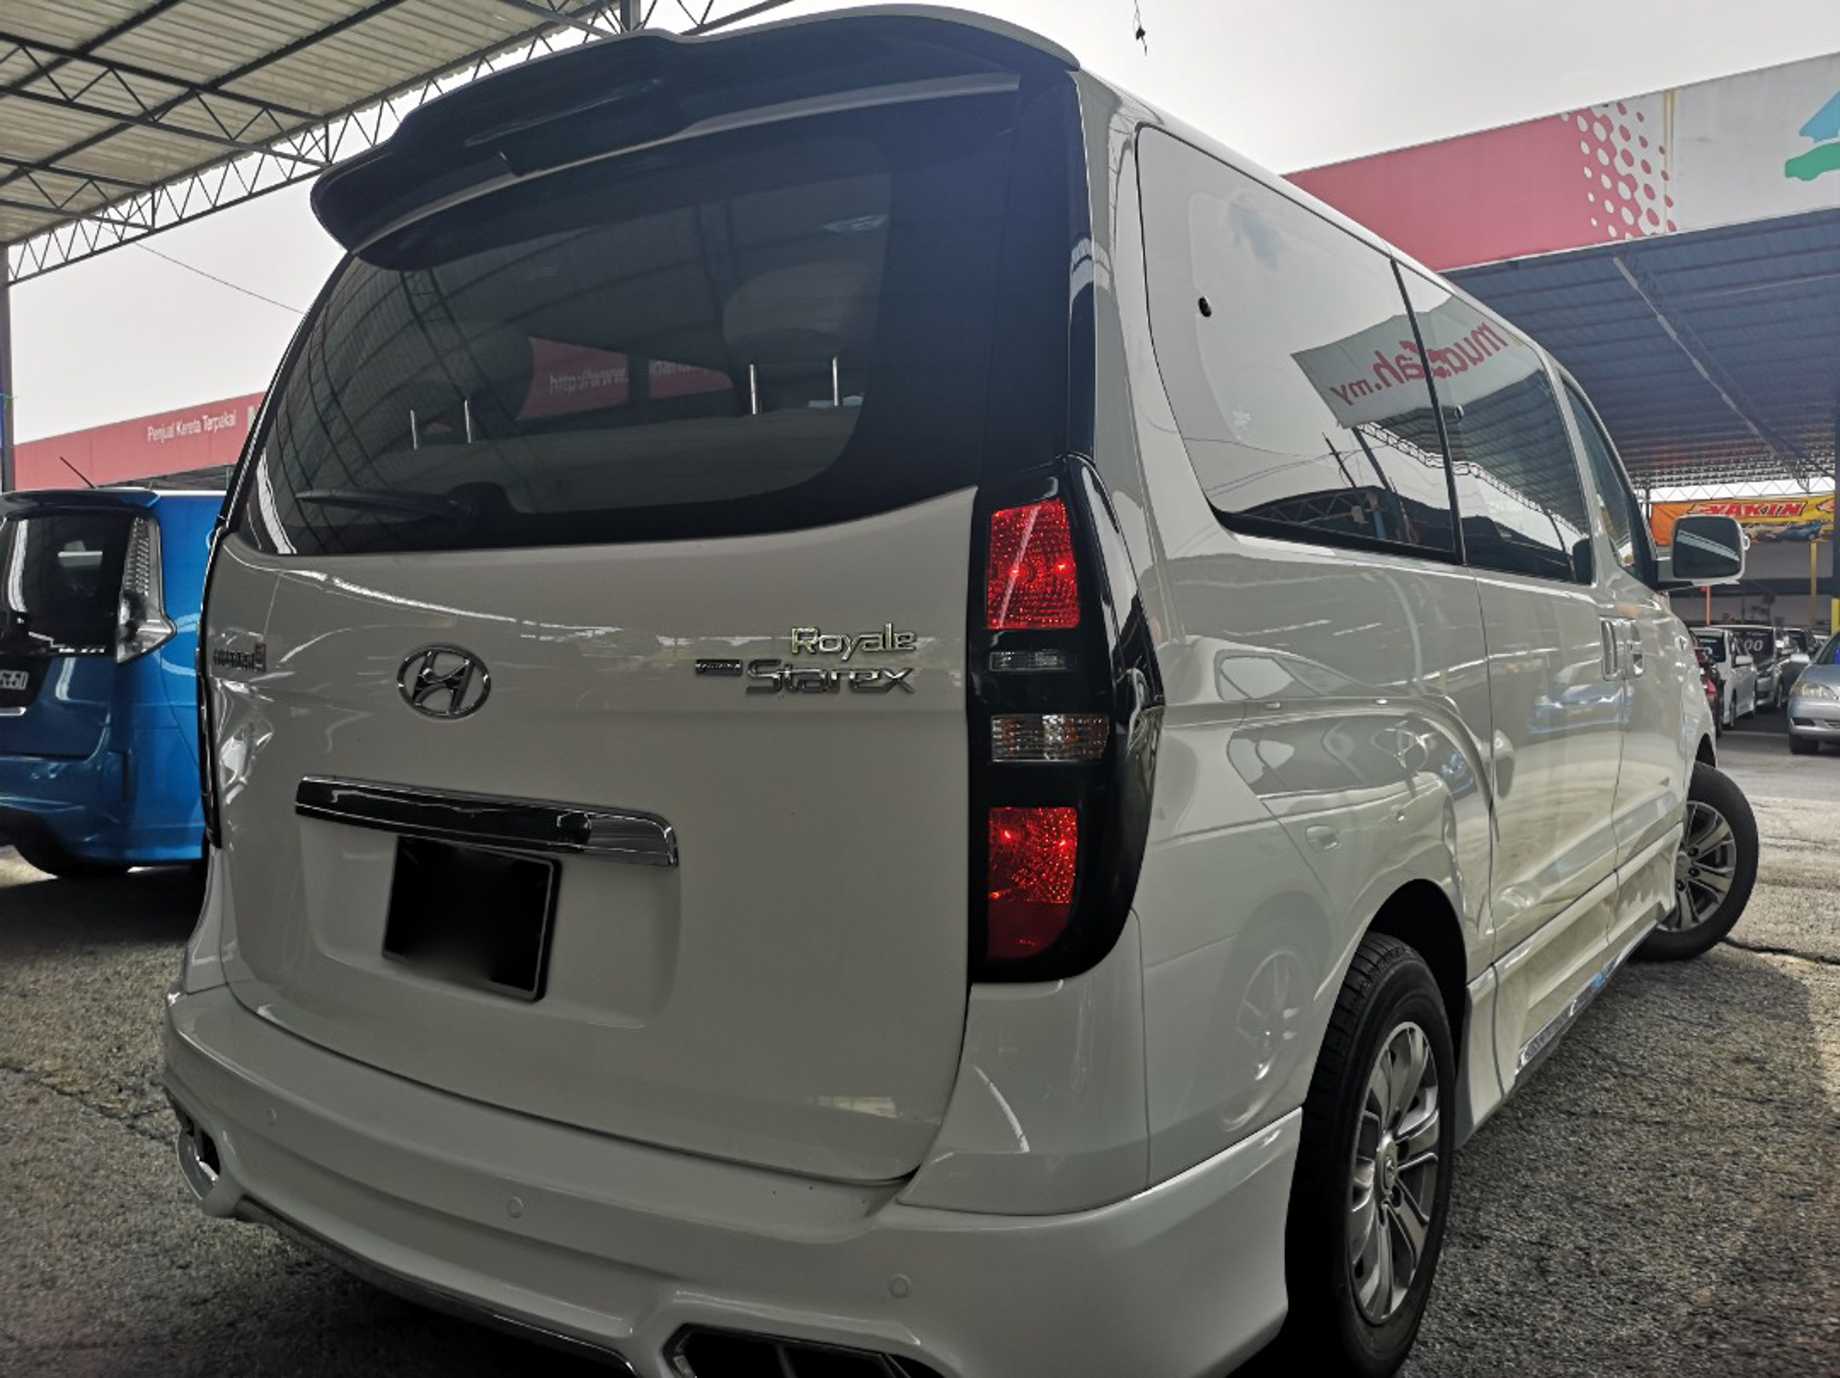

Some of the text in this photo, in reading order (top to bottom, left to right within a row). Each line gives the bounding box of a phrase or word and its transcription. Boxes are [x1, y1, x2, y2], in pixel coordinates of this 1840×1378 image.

[147, 409, 237, 442] Penjual Kereta Terpakai
[790, 622, 918, 661] Royale
[746, 658, 915, 695] Starex
